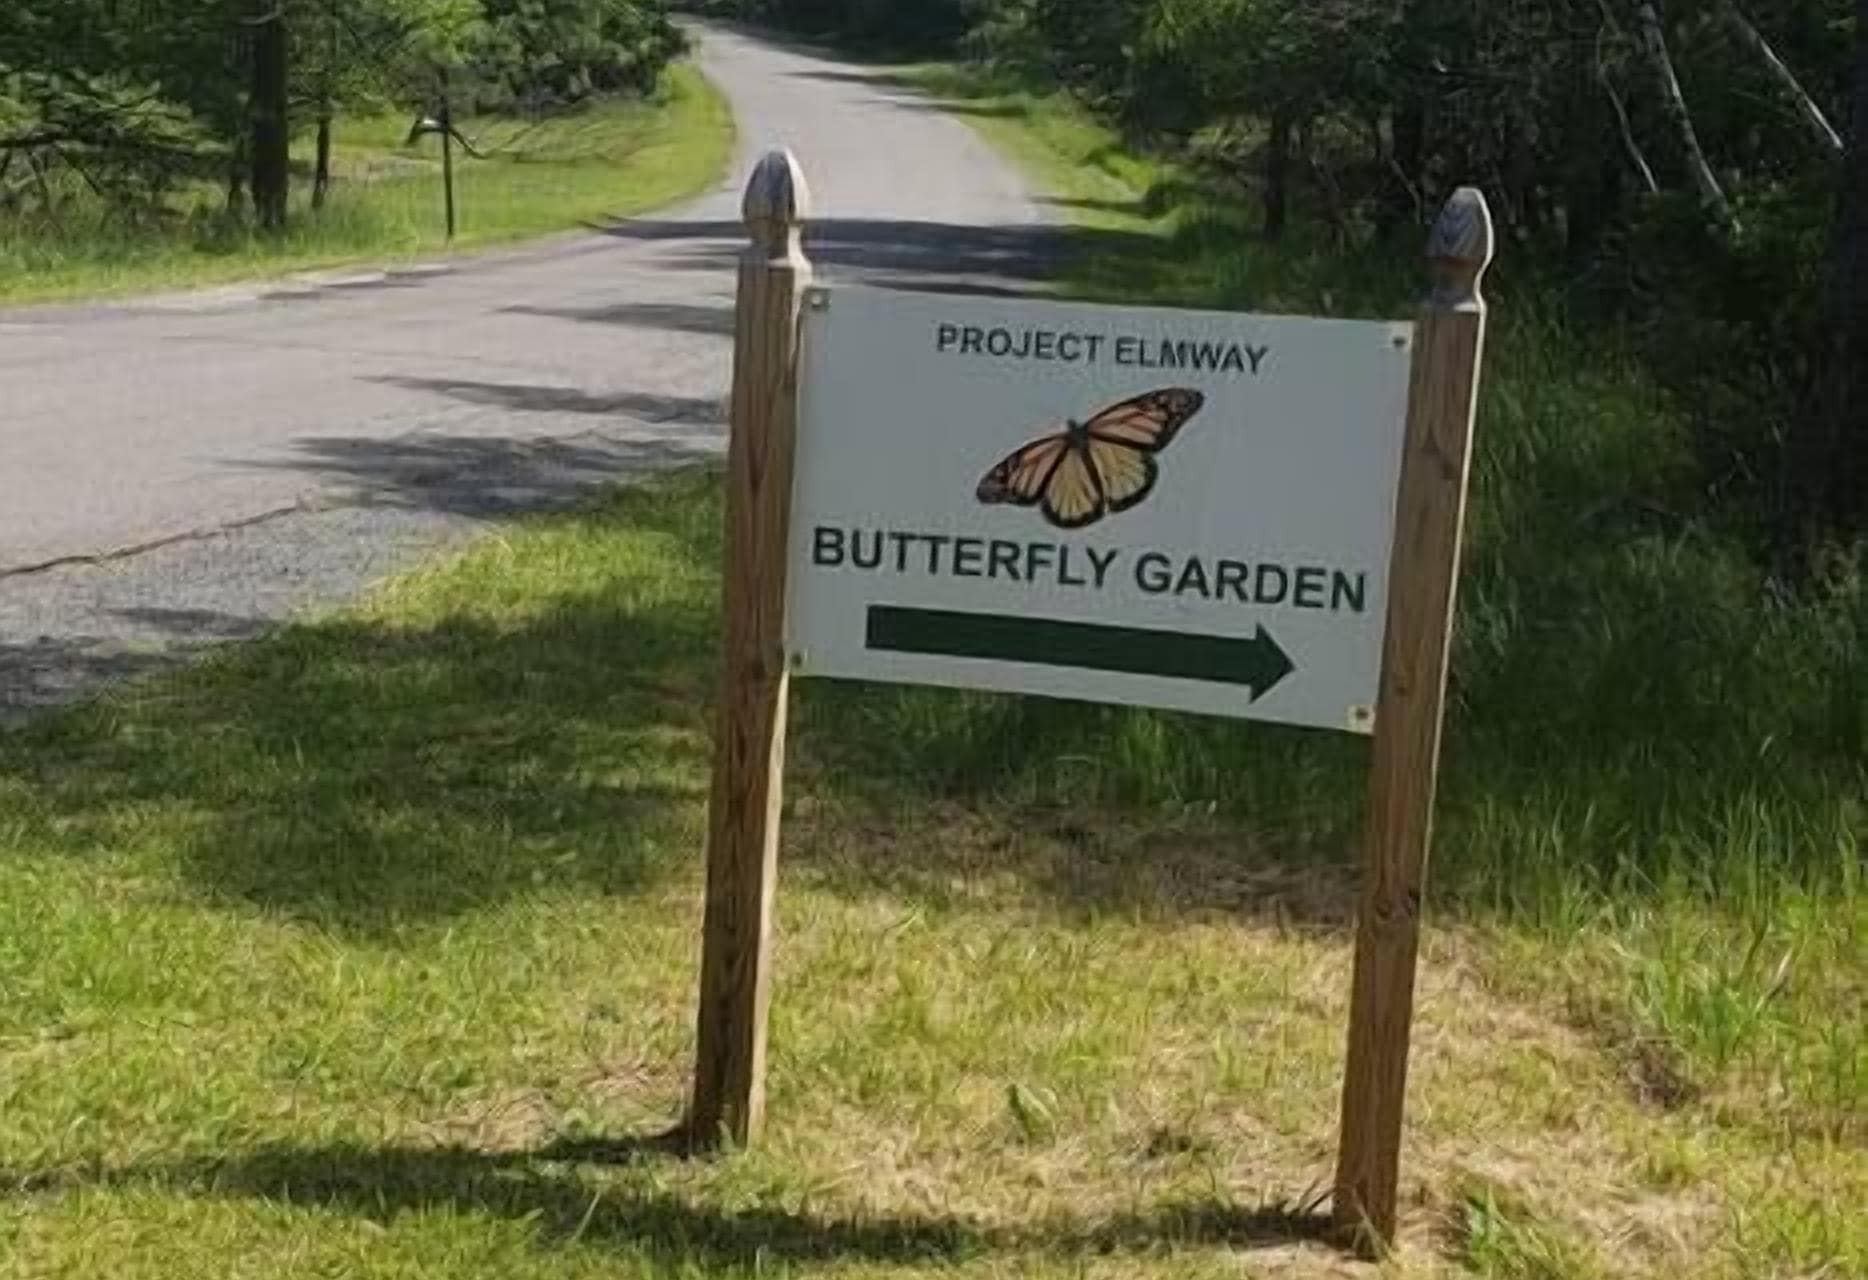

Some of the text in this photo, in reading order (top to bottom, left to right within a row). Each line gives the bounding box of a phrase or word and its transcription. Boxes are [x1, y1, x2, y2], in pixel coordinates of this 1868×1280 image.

[936, 323, 1268, 375] PROJECT ELMWAY
[811, 526, 1368, 613] BUTTERFLY GARDEN
